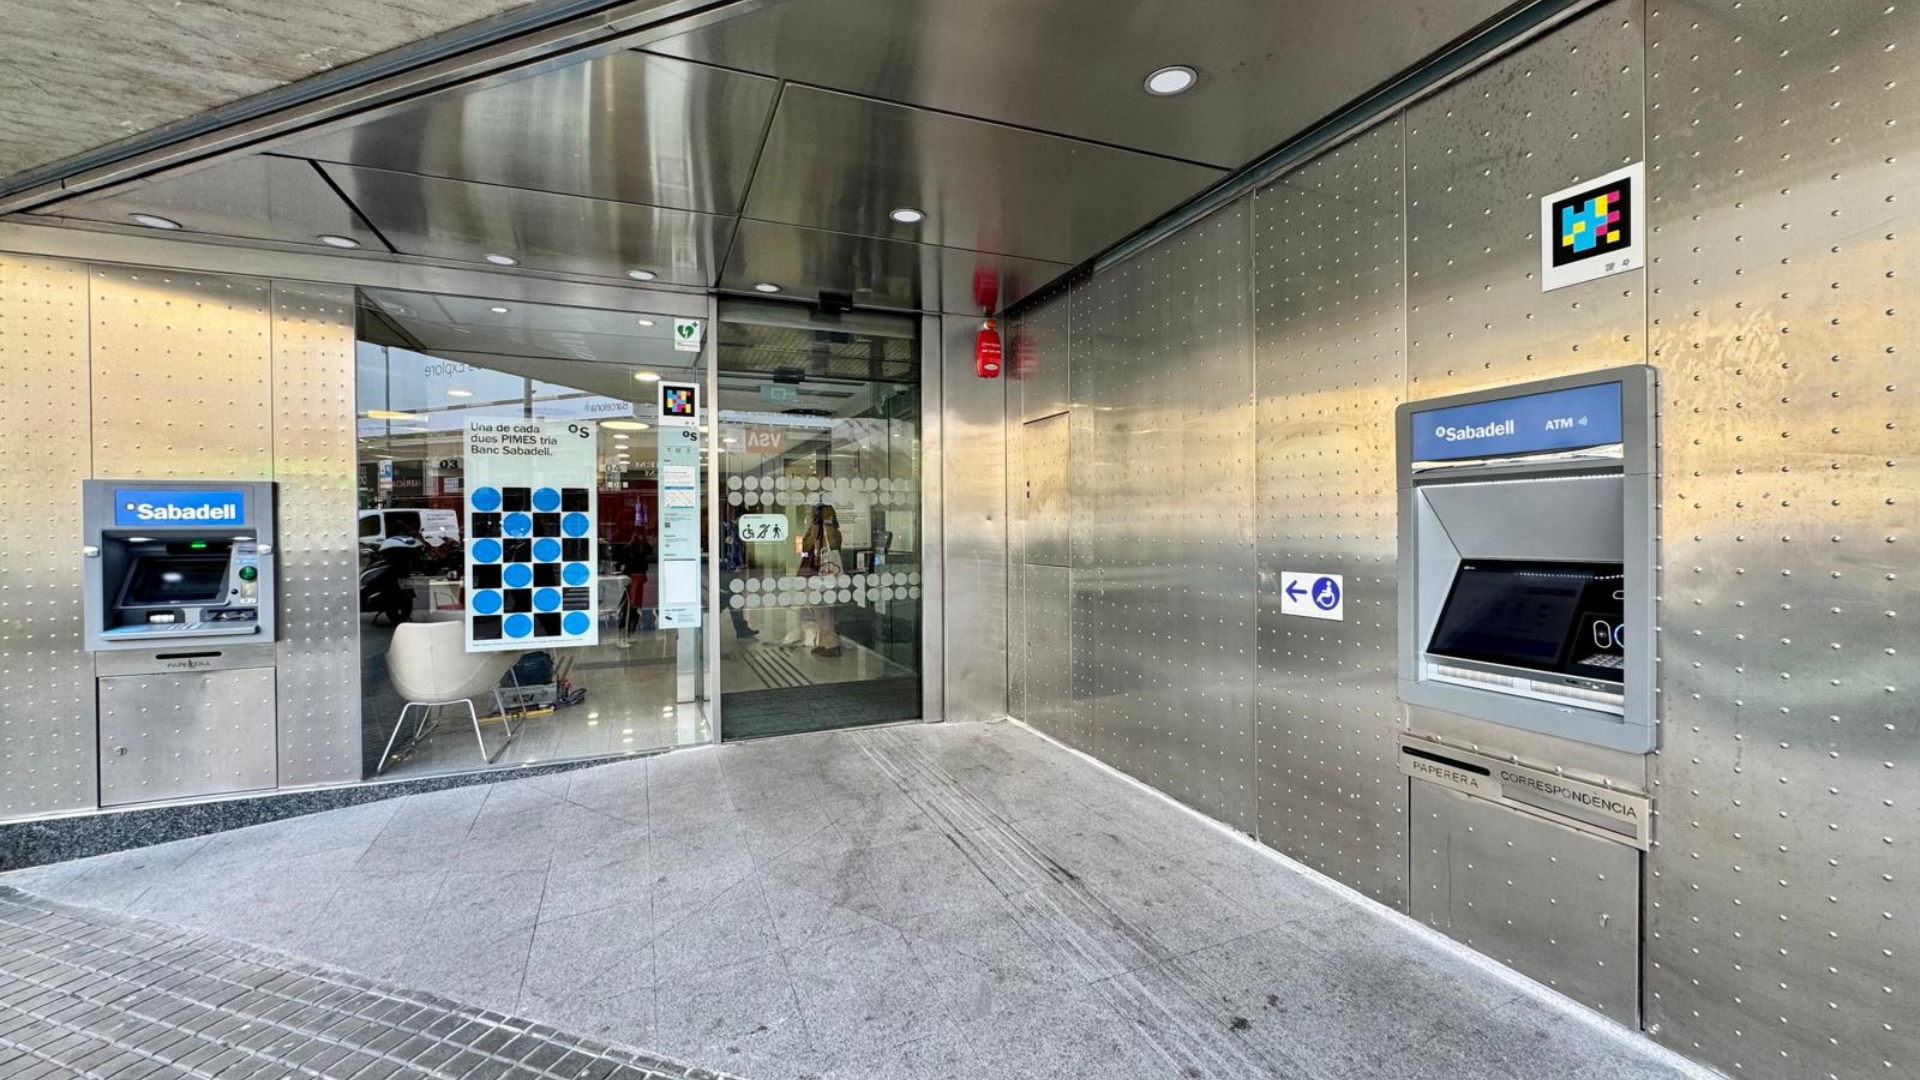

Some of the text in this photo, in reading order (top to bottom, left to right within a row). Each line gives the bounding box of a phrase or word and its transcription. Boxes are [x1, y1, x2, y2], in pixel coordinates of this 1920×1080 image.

[470, 422, 540, 434] Una de cada
[1545, 417, 1573, 431] ATM
[470, 434, 557, 445] dues PIMES tria
[470, 445, 500, 455] Banc
[440, 460, 458, 469] 03
[1413, 761, 1479, 788] PAPERERA
[1500, 769, 1637, 819] CORRESPONDÈNCIA
